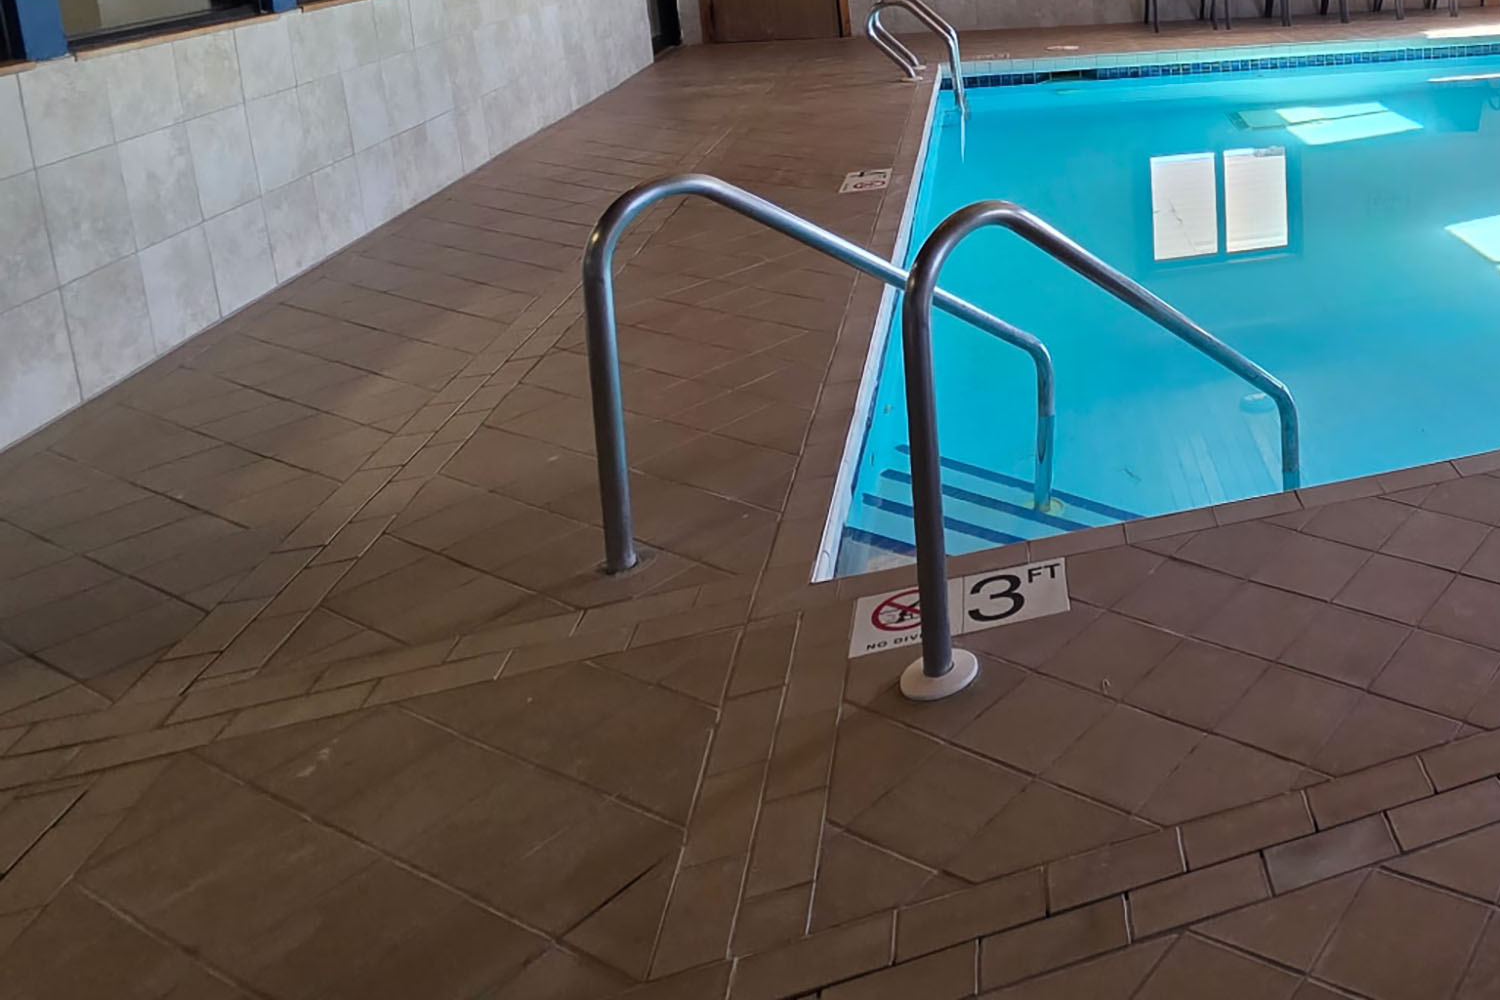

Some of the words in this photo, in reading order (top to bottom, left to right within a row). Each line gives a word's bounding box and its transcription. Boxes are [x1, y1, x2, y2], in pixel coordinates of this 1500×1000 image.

[968, 574, 1025, 622] 3
[1027, 562, 1060, 583] FT
[866, 640, 888, 651] NO
